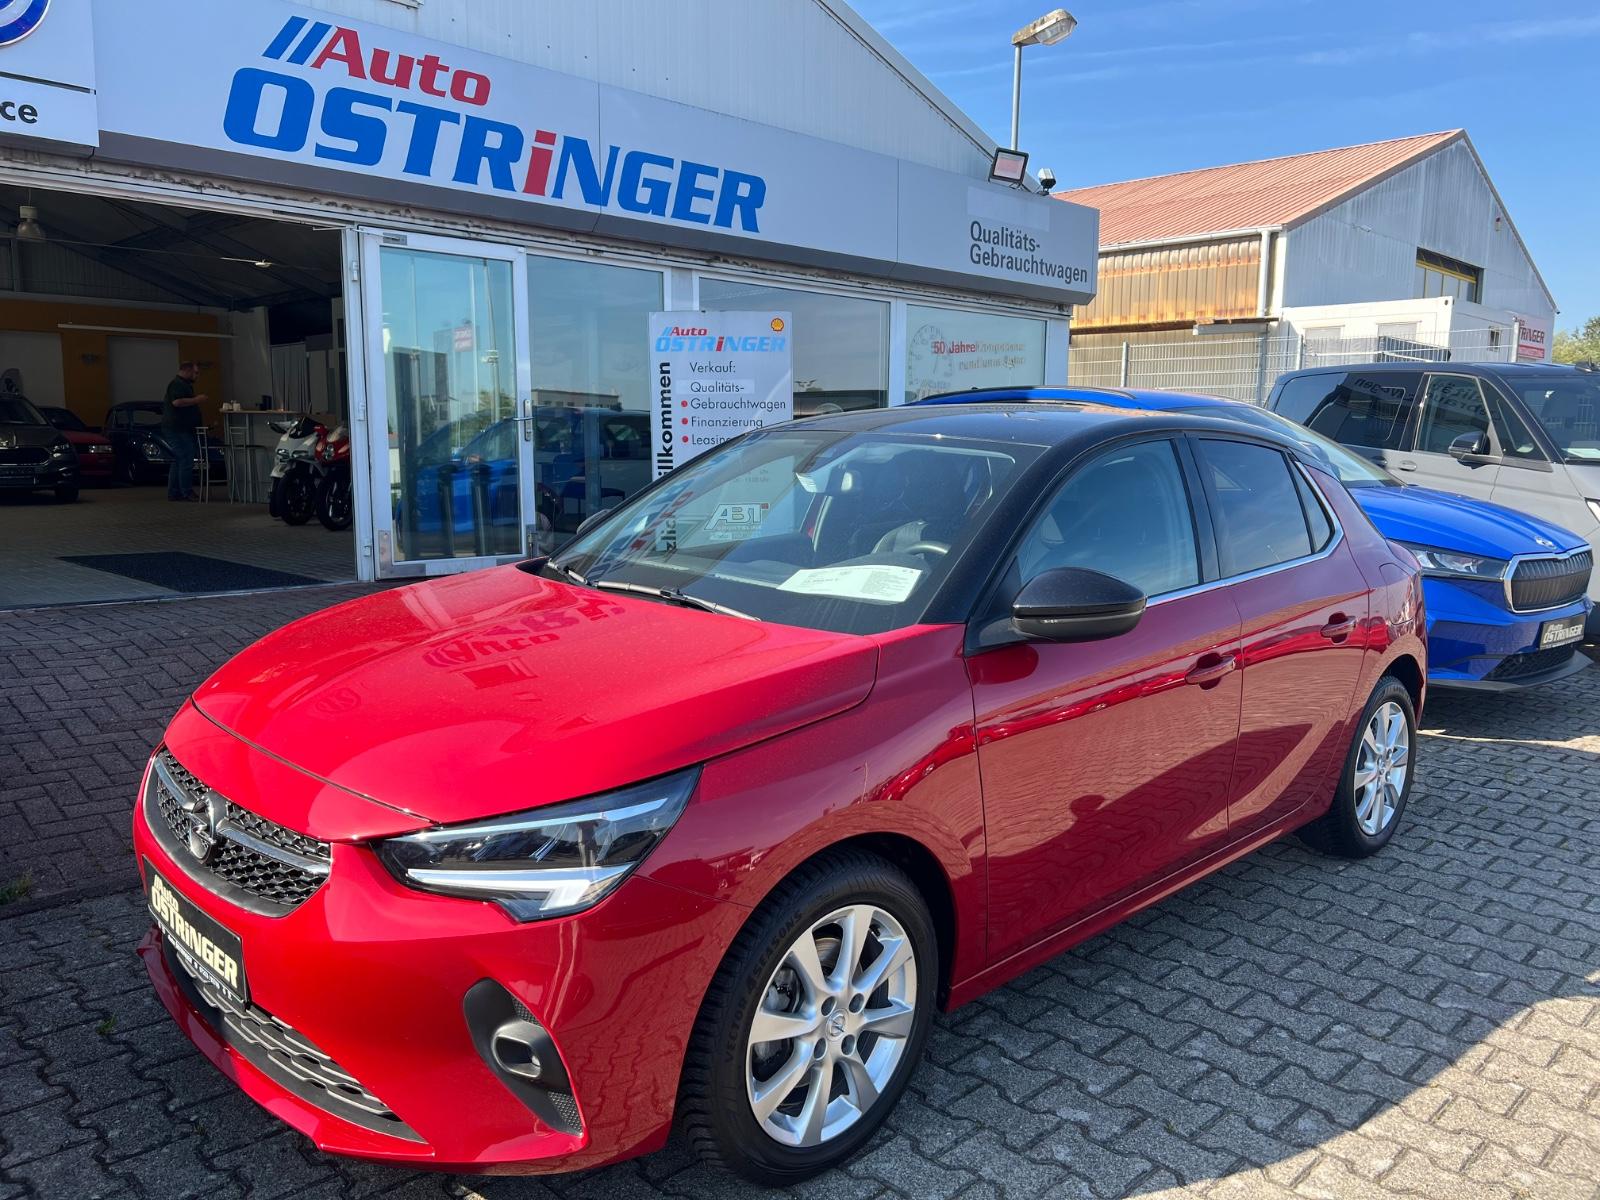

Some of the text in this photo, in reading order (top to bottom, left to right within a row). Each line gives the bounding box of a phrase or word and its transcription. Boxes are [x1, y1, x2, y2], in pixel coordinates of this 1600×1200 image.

[310, 25, 491, 107] Auto
[0, 100, 38, 124] ce
[970, 221, 1040, 252] Qualitäts-
[970, 243, 1088, 285] Gebrauchtwagen
[670, 326, 708, 336] Auto
[949, 340, 976, 354] Jahre
[689, 361, 736, 373] Verkauf:
[690, 381, 745, 393] Qualitäts-
[690, 397, 786, 412] Gebrauchtwagen
[657, 362, 674, 476] illkommen
[691, 416, 763, 428] Finanzierung
[692, 433, 731, 445] Leasin
[704, 503, 769, 530] ABT
